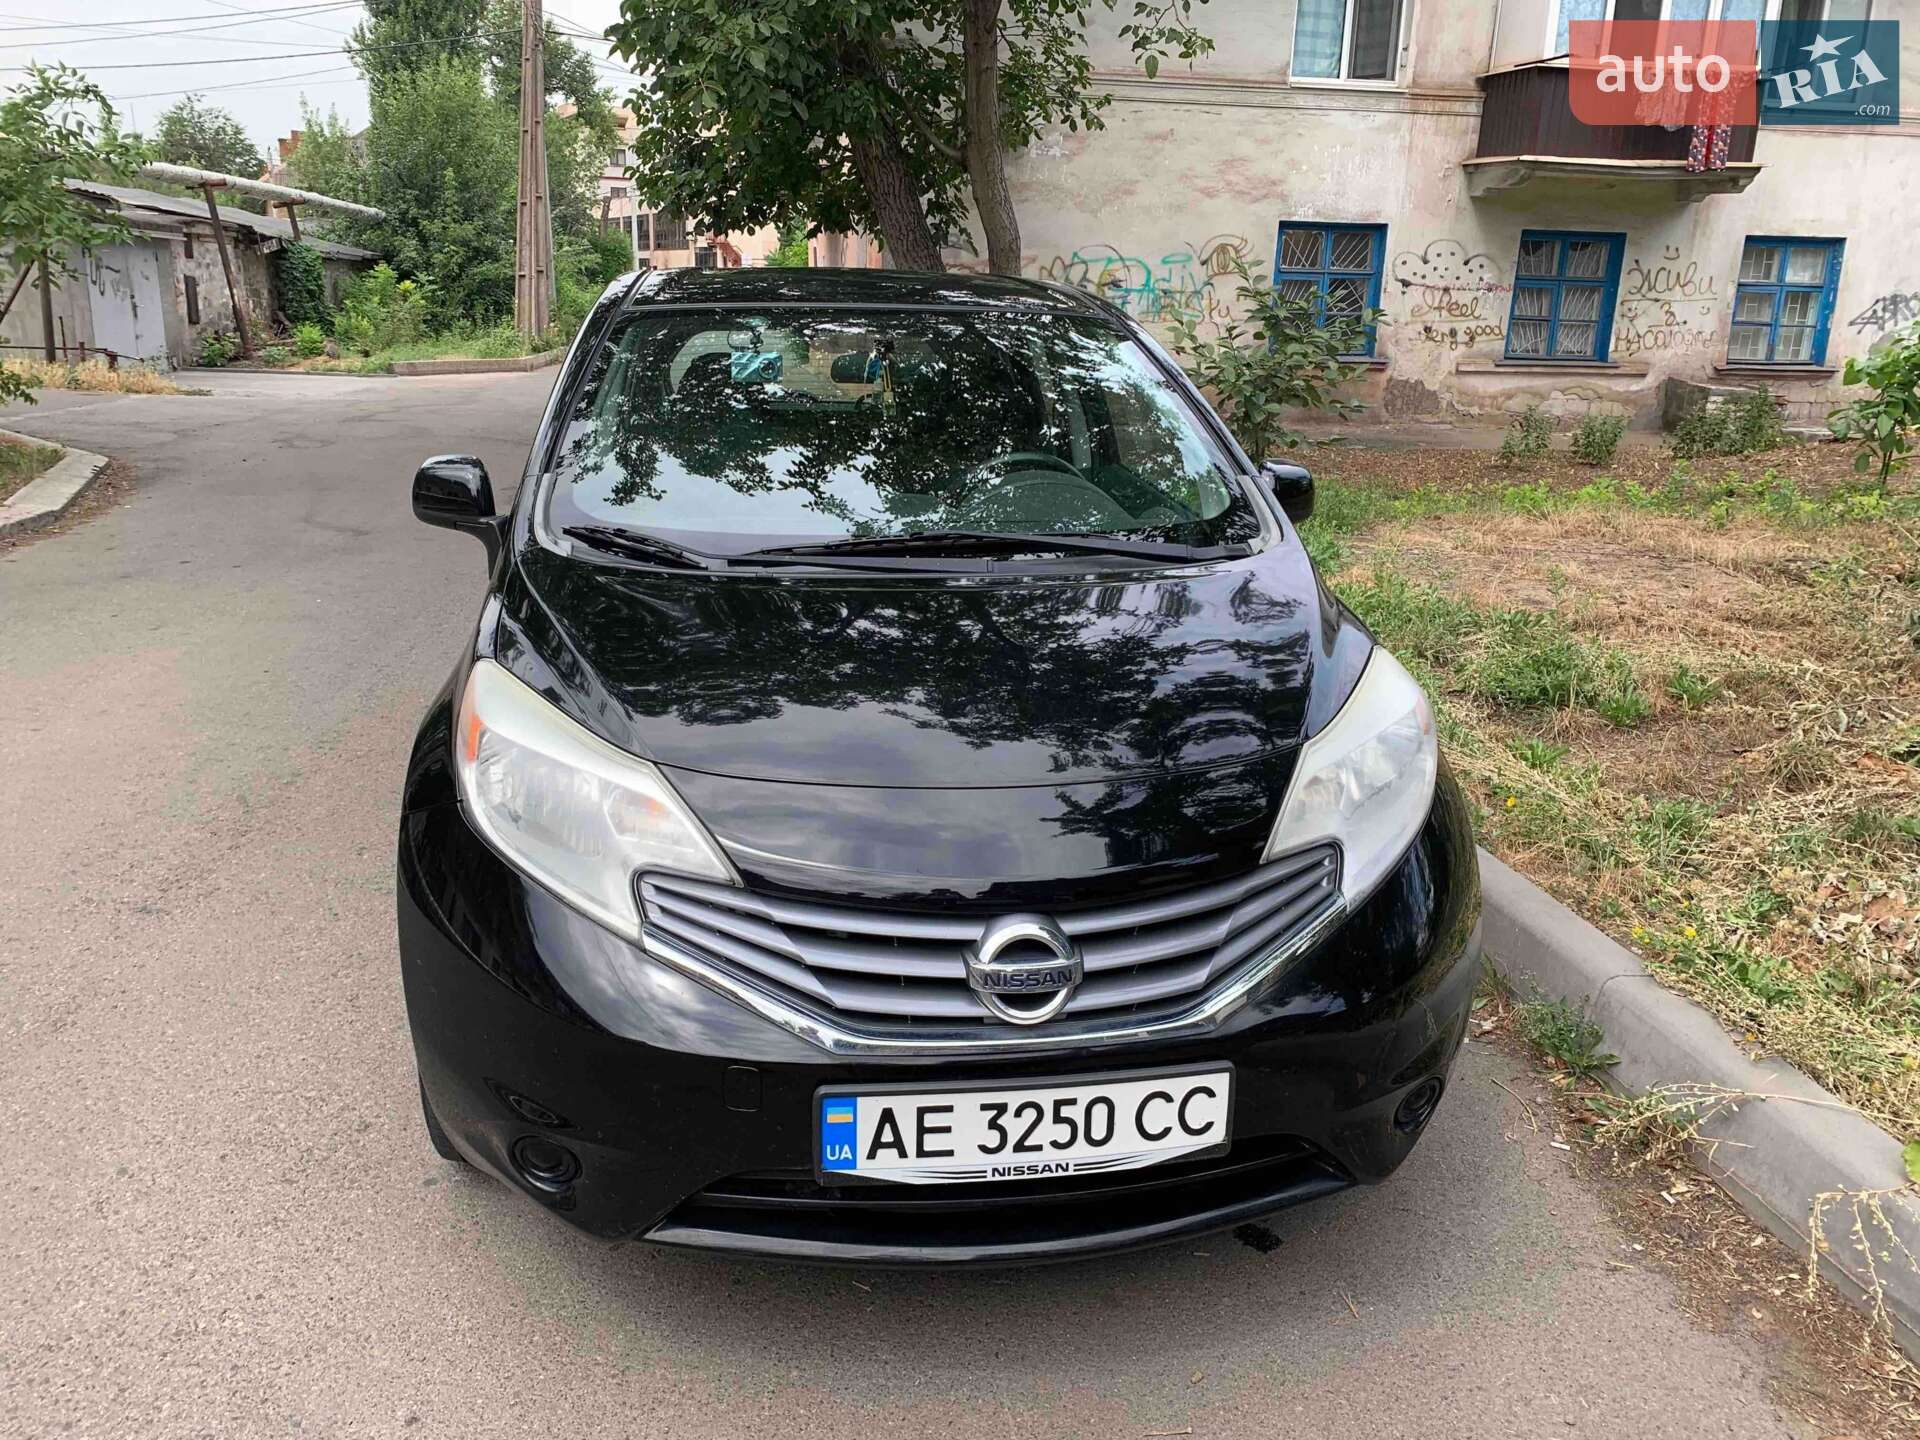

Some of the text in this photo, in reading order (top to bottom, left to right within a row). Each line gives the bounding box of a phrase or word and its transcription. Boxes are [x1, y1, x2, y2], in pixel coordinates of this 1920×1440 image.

[983, 968, 1073, 989] NISSAN
[866, 1086, 1217, 1160] AE 3250 CC
[826, 1144, 853, 1161] UA
[991, 1162, 1070, 1178] NISSAN
